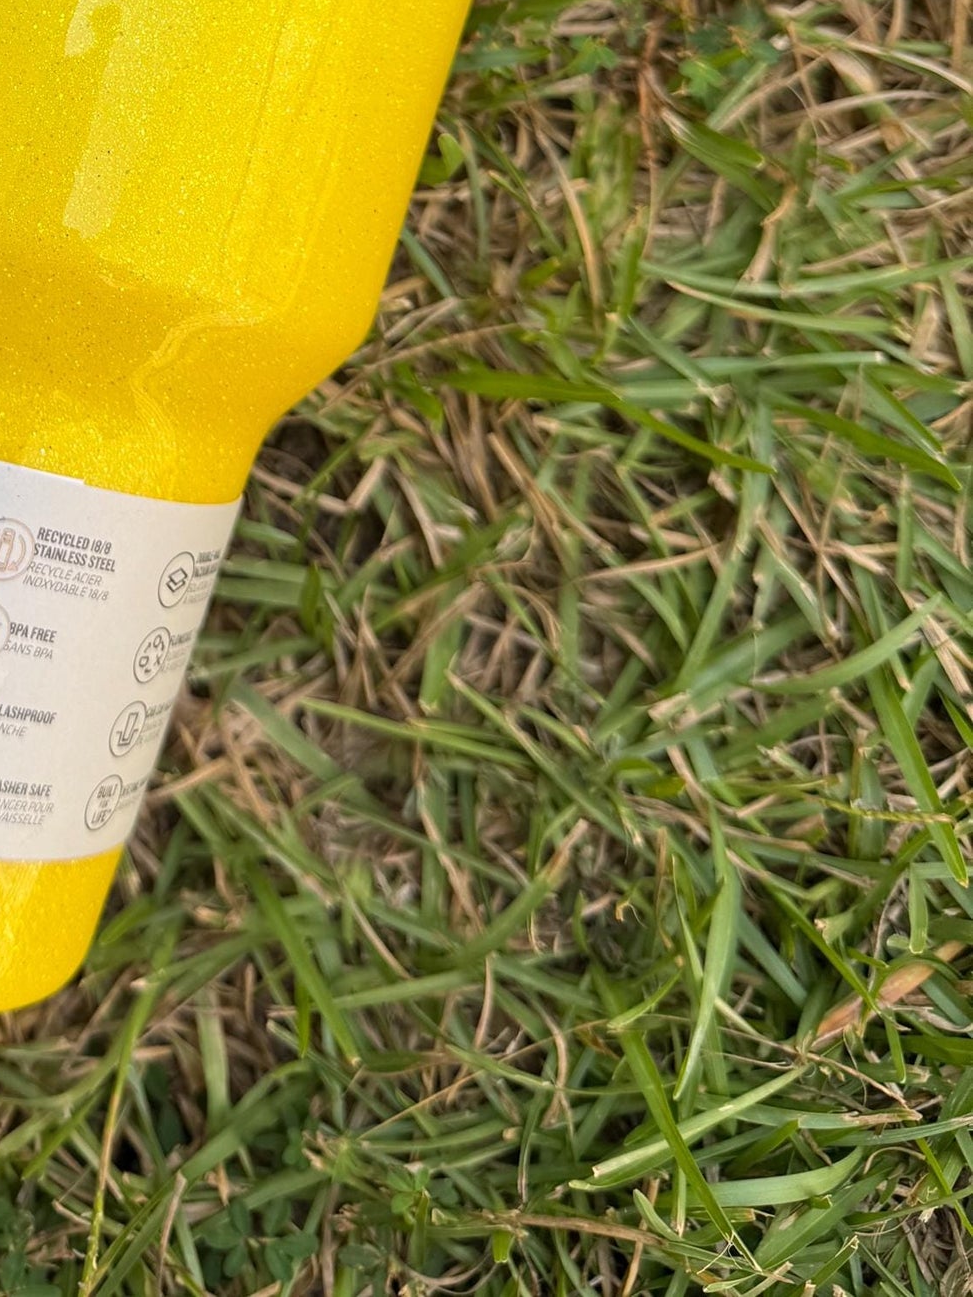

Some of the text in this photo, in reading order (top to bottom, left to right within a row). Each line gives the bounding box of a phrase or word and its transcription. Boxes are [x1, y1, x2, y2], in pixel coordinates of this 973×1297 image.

[37, 526, 113, 555] RECYCLED 18/8
[33, 543, 116, 572] STAINLESS STEEL
[22, 574, 110, 601] INOXYDABLE 18/8
[73, 571, 103, 587] ACIER
[9, 621, 57, 643] BPA FREE
[3, 640, 54, 660] SANS BPA
[28, 784, 52, 798] SAFE
[27, 802, 55, 814] POUR
